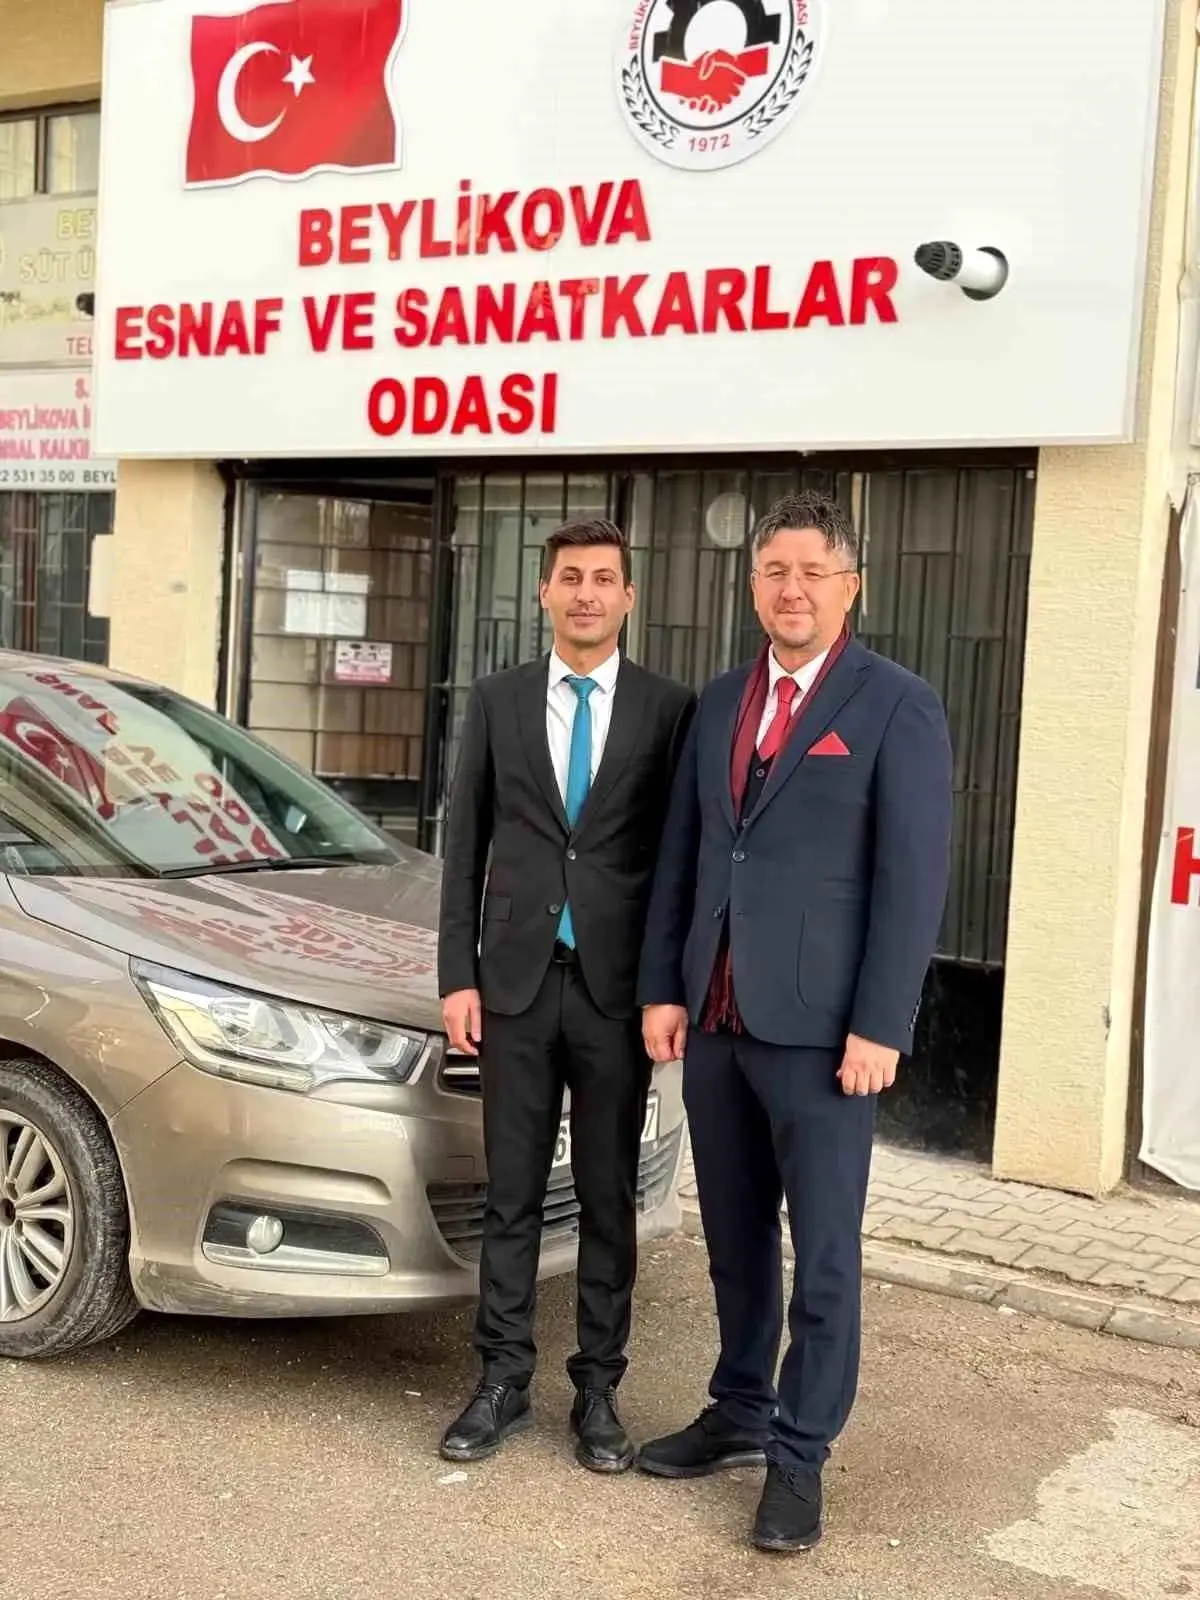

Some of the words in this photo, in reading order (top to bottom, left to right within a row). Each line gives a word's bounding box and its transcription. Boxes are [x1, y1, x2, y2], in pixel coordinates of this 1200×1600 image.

[688, 134, 731, 153] 1972
[298, 179, 650, 267] BEYLİKOVA
[115, 298, 284, 360] ESNAF
[303, 292, 376, 352] VE
[394, 257, 899, 349] SANATKARLAR
[367, 373, 558, 437] ODASI
[13, 470, 35, 483] 531
[59, 470, 75, 483] 00
